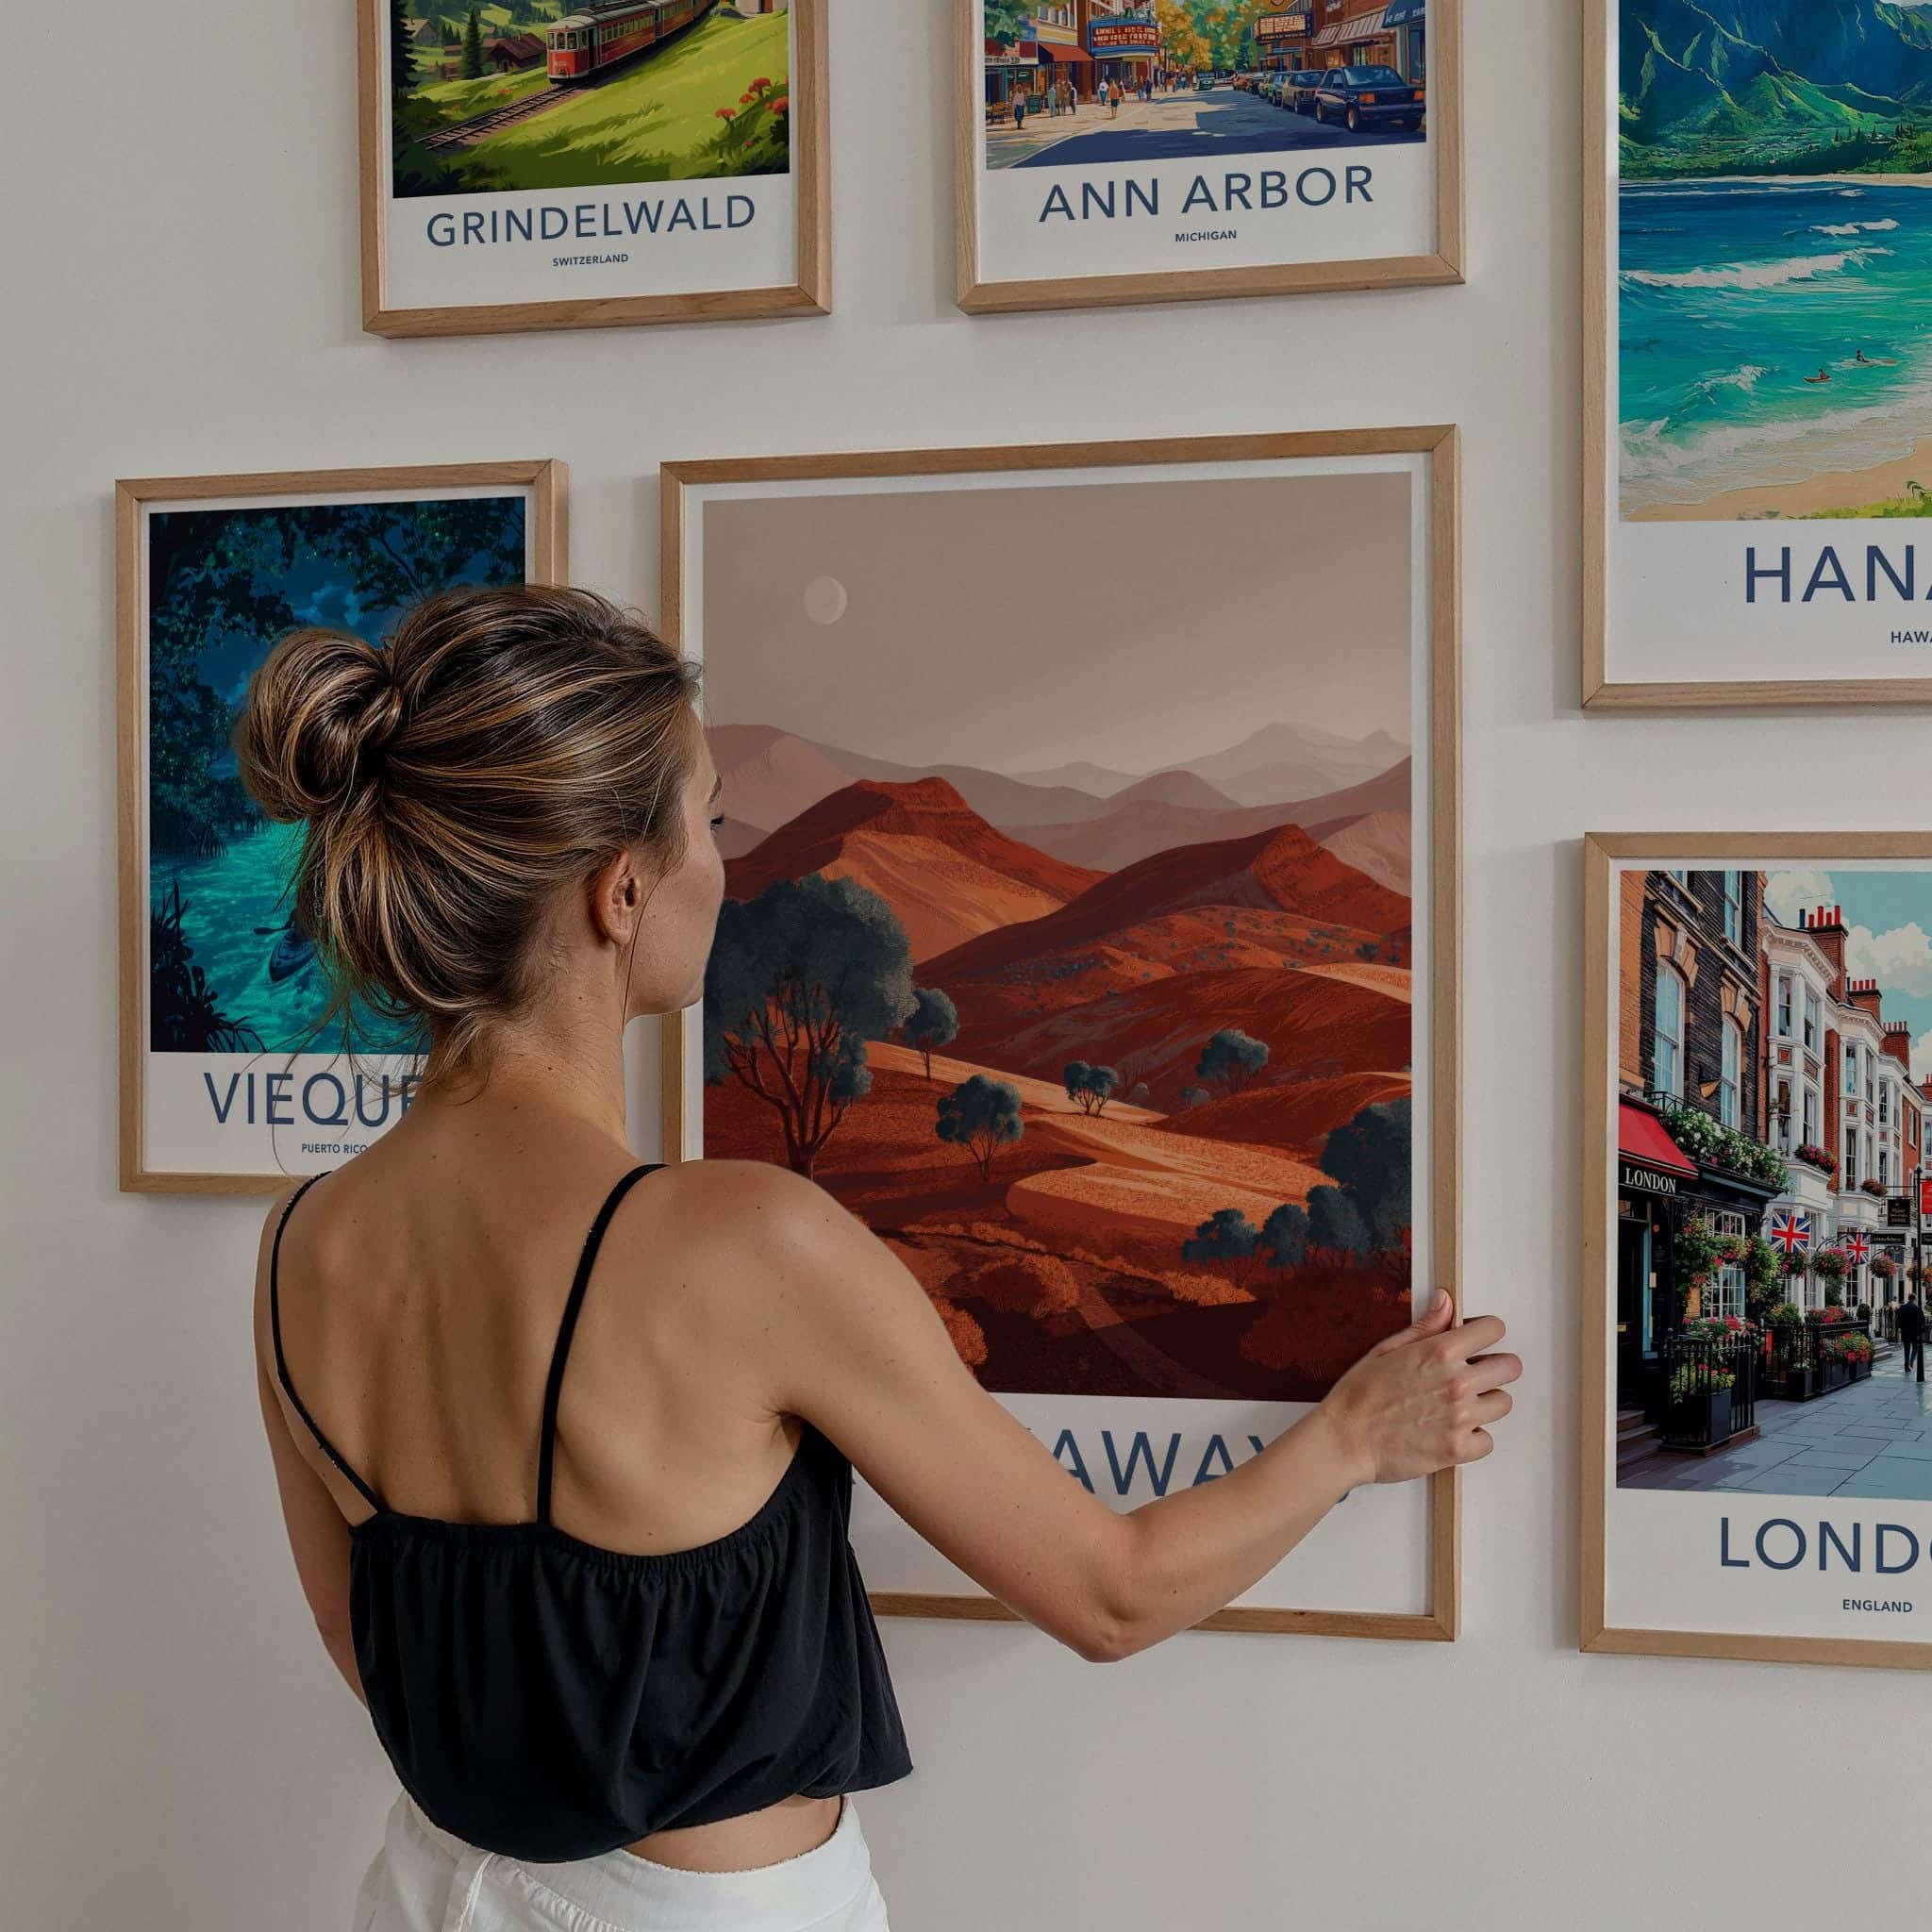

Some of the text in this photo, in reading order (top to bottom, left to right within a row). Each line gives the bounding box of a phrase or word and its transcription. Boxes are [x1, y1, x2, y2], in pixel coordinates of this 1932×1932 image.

[1038, 165, 1374, 223] ANN ARBOR
[426, 194, 756, 247] GRINDELWALD
[1174, 229, 1238, 242] MICHIGAN
[552, 253, 629, 267] SWITZERLAND
[1745, 544, 1932, 604] HAN
[1890, 630, 1932, 644] HAW
[301, 1142, 368, 1155] PUERTO RICO
[1625, 1167, 1676, 1193] LONDON
[1720, 1516, 1932, 1574] LOND
[1842, 1598, 1913, 1613] ENGLAND
